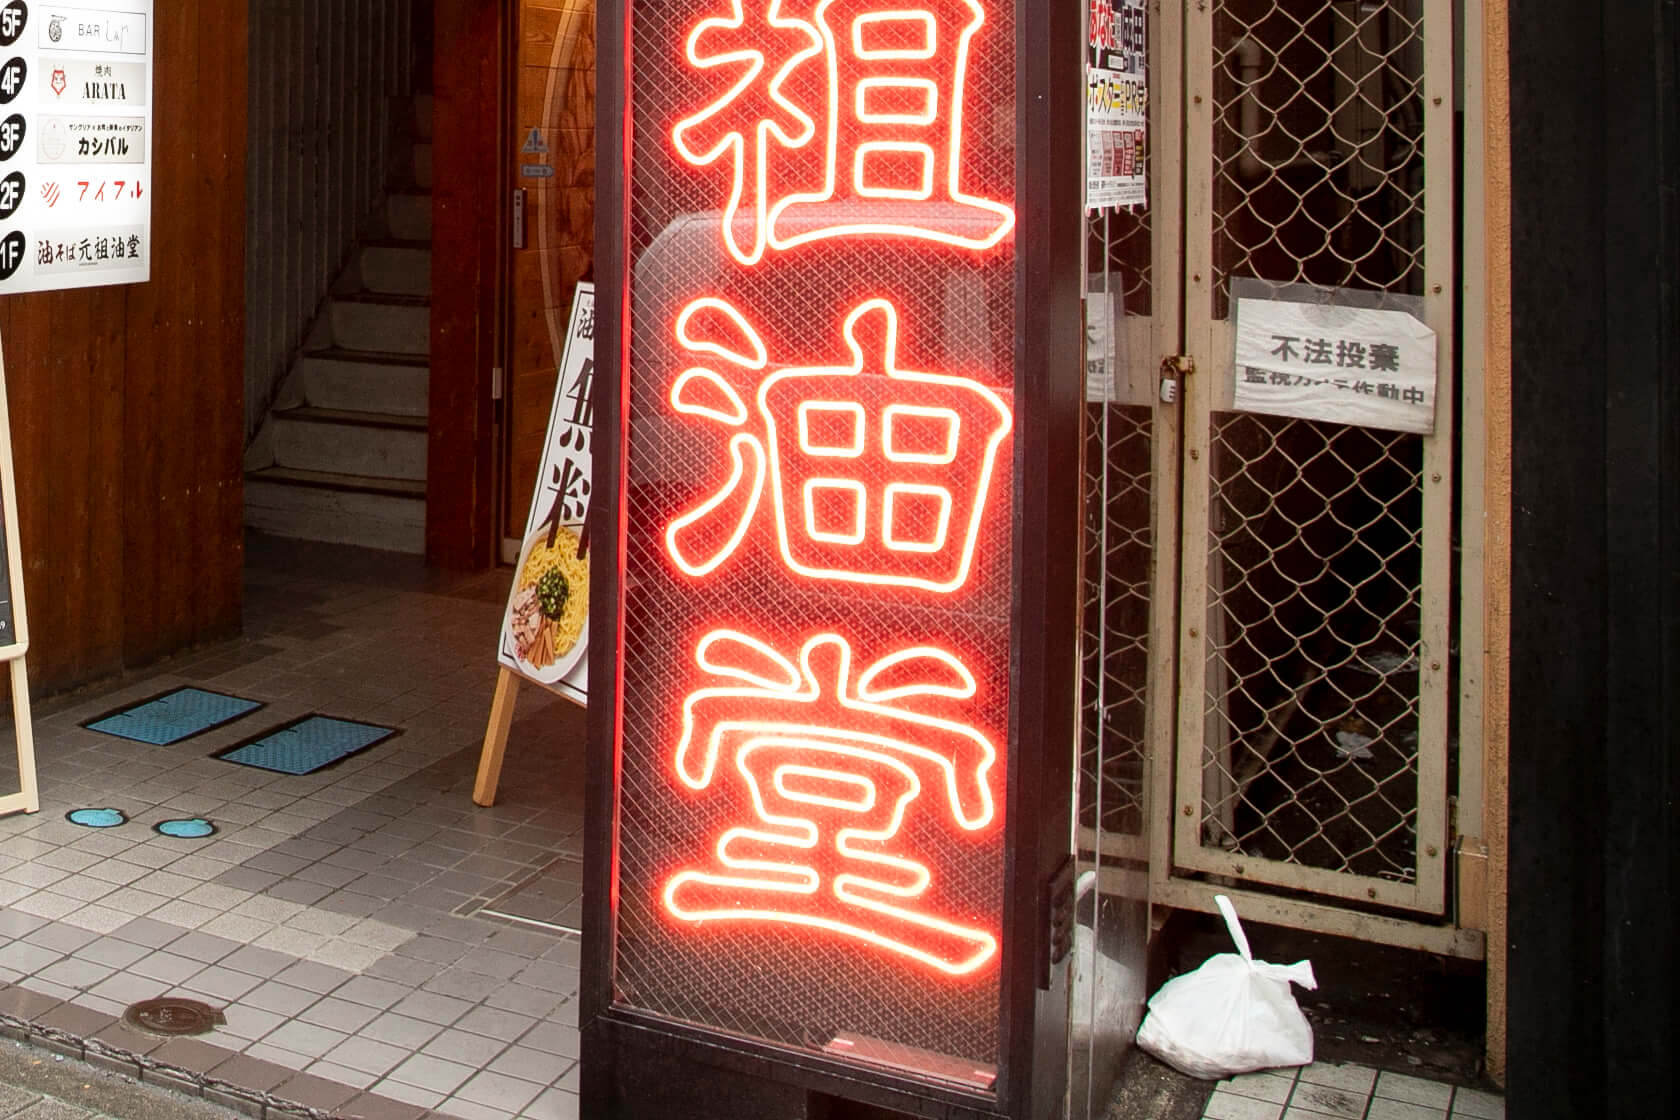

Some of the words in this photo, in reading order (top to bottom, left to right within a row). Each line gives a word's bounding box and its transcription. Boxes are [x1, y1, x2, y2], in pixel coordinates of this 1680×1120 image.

[2, 9, 22, 37] 5F
[78, 23, 100, 37] BAR
[1, 66, 21, 95] 4F
[83, 82, 126, 100] ARATA
[0, 123, 20, 151] 3F
[78, 136, 129, 156] カシバル
[0, 181, 20, 210] 2F
[77, 180, 143, 202] アイフル
[0, 241, 19, 269] 1F
[1271, 335, 1400, 372] 不法投棄
